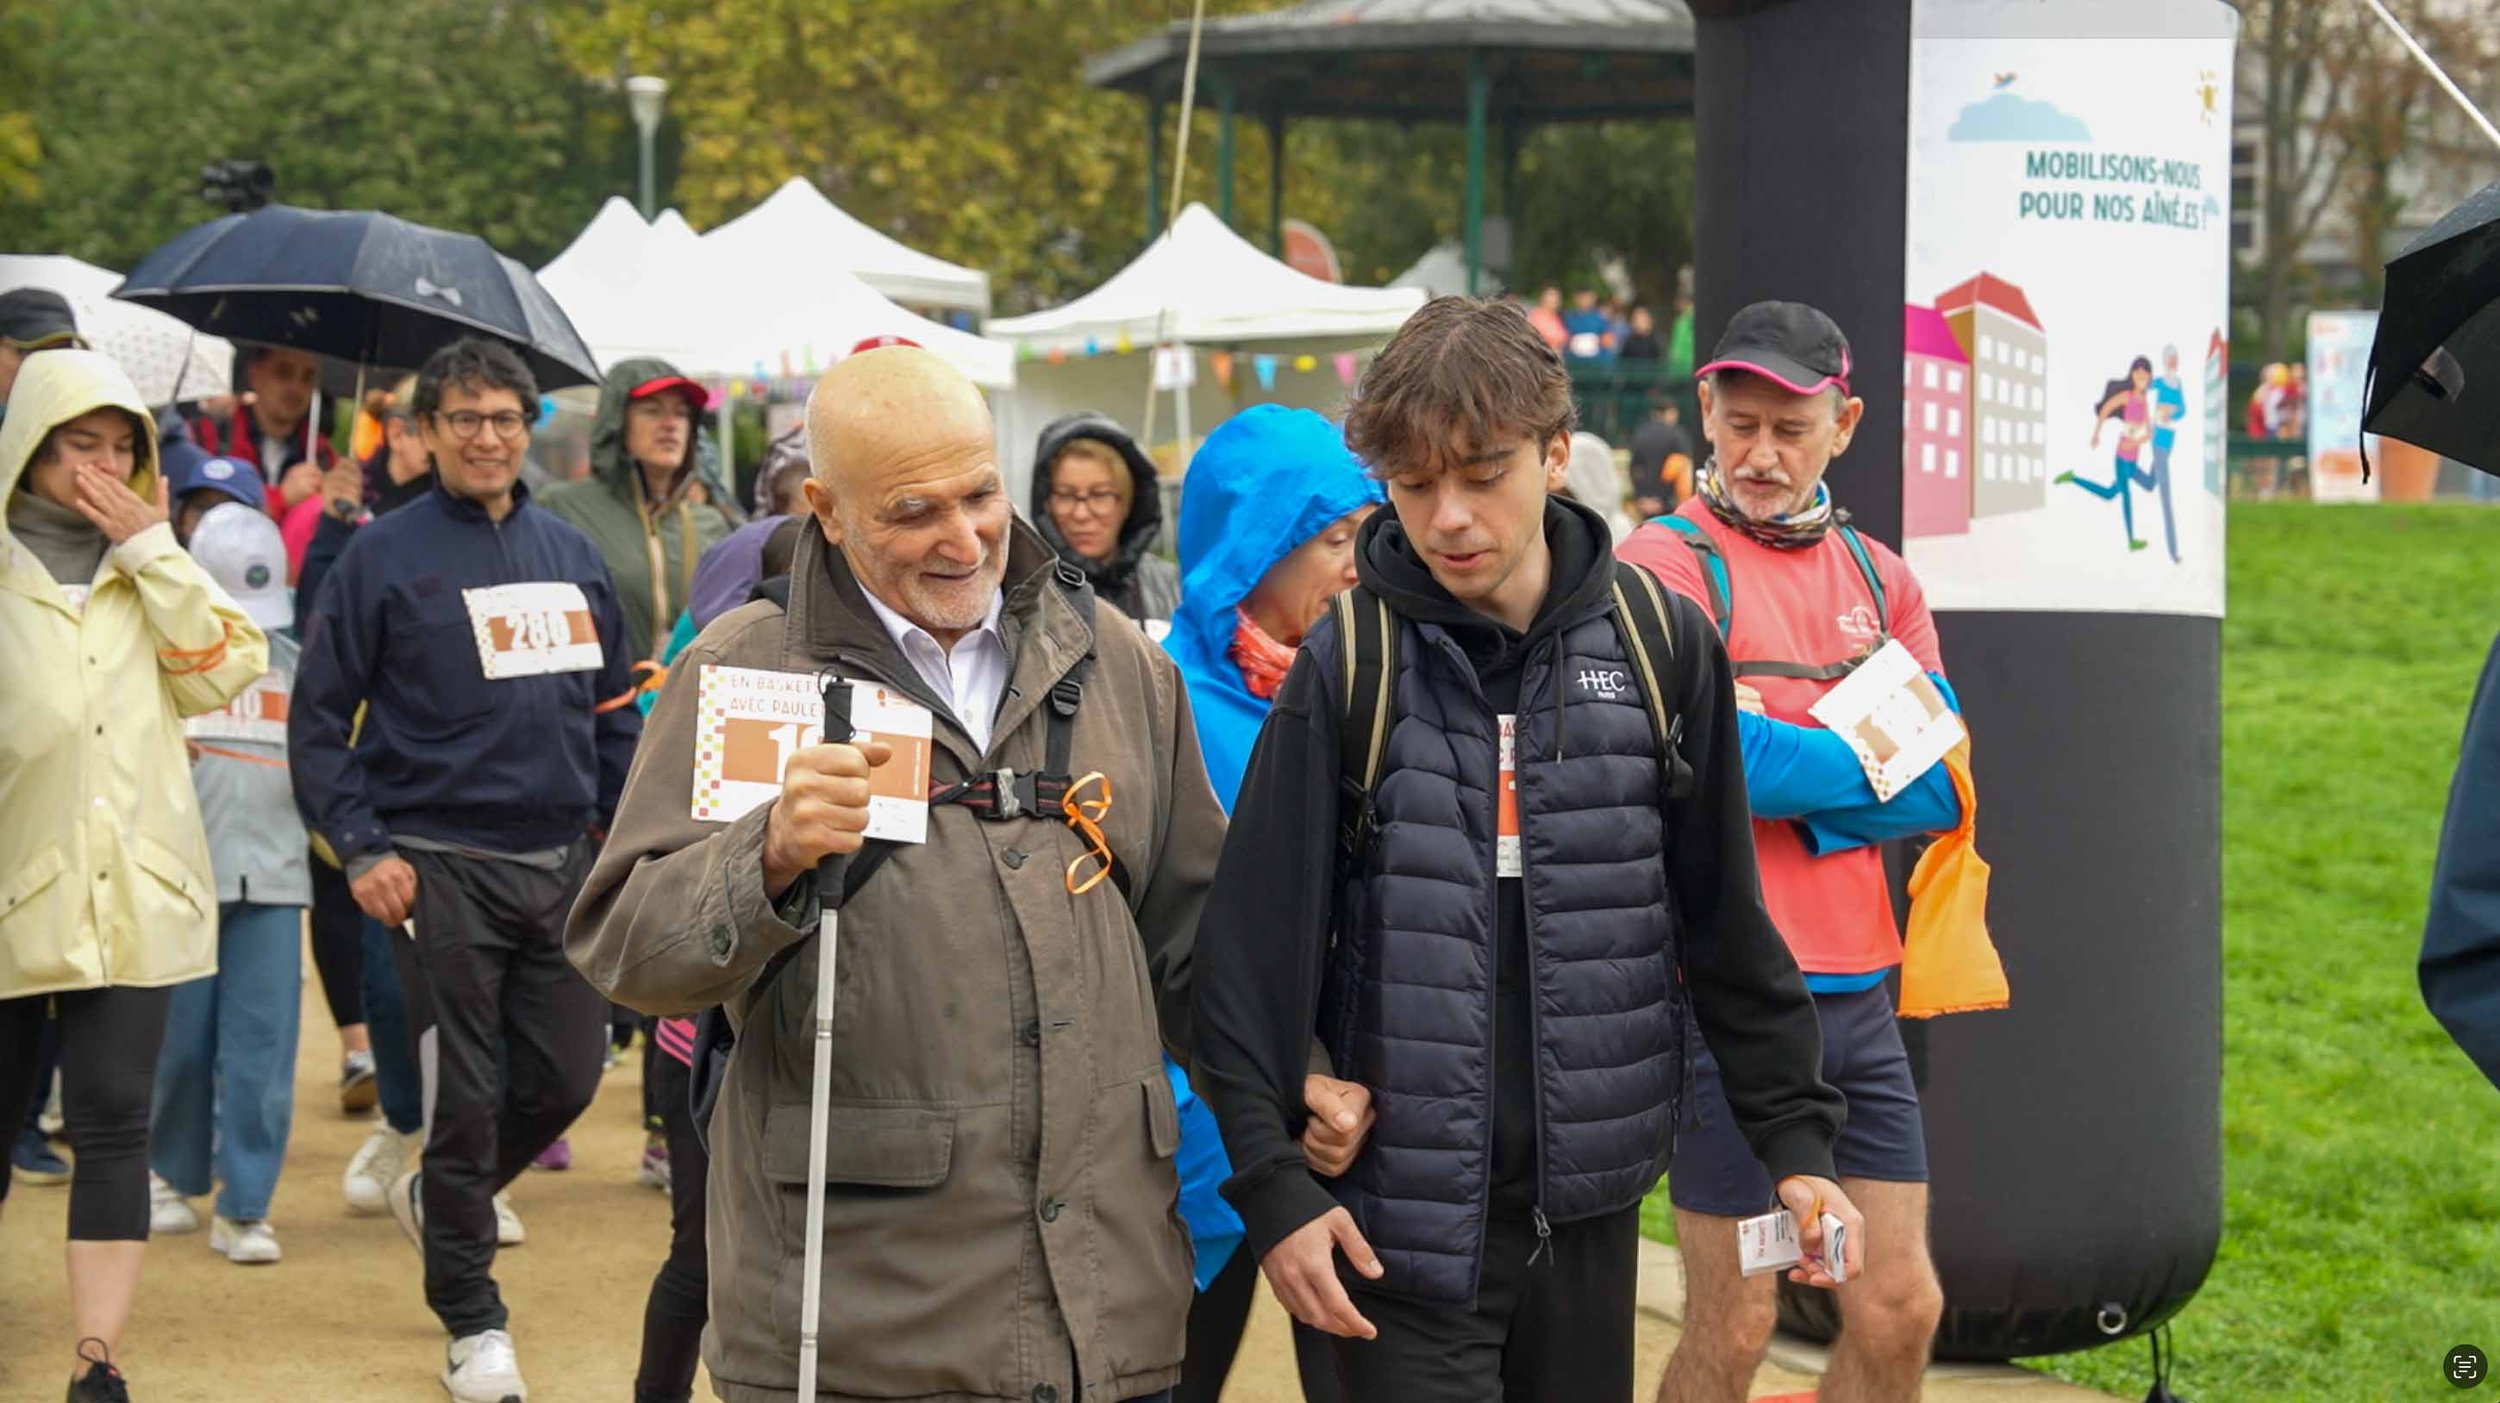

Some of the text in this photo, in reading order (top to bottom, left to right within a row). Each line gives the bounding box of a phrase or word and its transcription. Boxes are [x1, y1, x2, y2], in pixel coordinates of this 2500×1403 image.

[2026, 151, 2201, 190] MOBILISONS-NOUS
[2020, 192, 2083, 219] POUR
[2093, 194, 2135, 222] NOS
[731, 673, 750, 688] EN
[1577, 670, 1626, 692] HEC
[730, 698, 825, 717] AVEC PAULE
